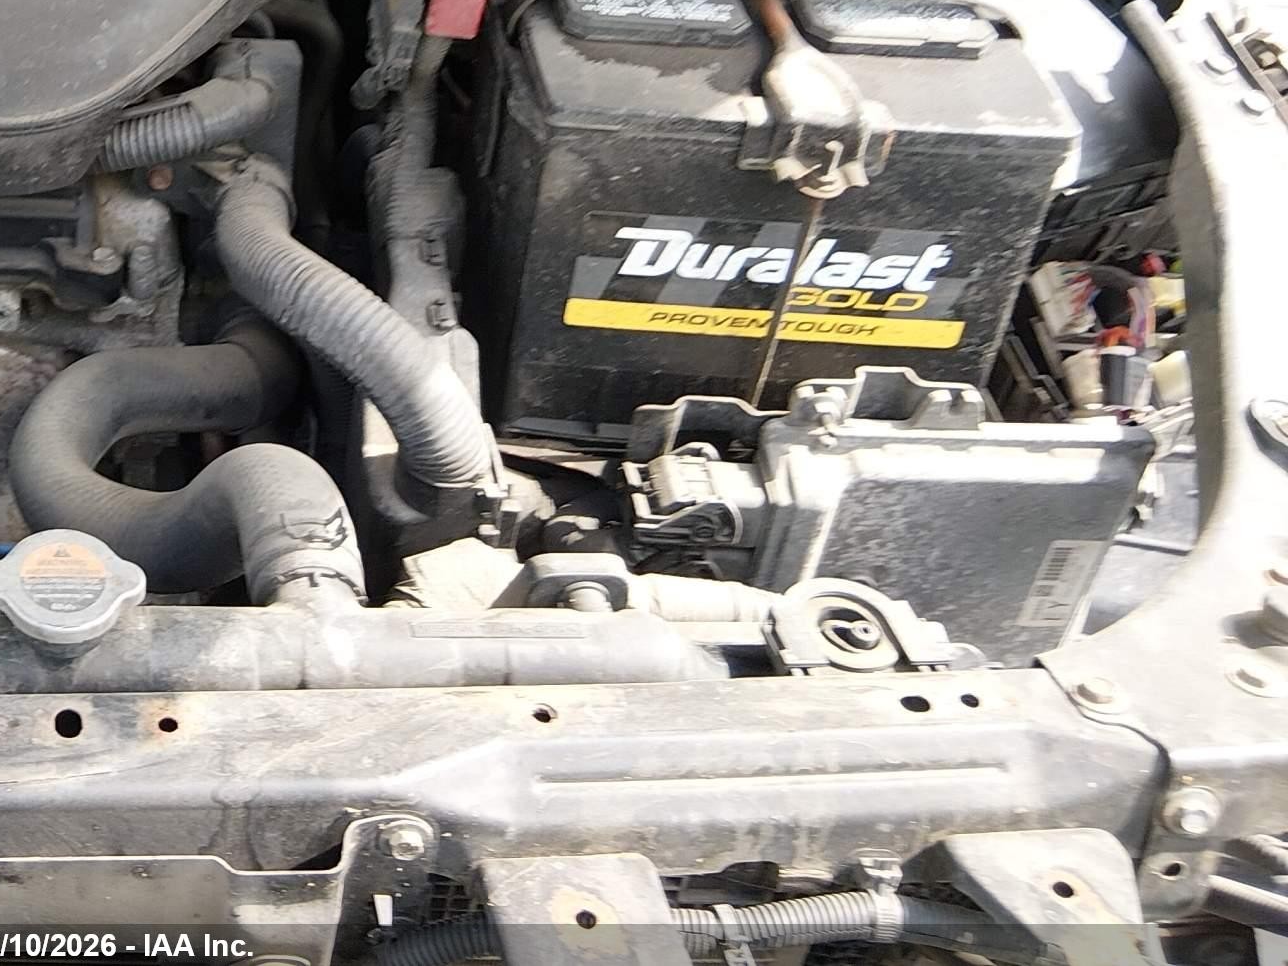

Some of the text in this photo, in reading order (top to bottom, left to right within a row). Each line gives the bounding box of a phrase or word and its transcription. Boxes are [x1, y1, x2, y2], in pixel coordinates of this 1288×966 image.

[614, 227, 954, 292] Duralast
[786, 286, 929, 312] GOLD
[648, 311, 882, 335] PROVEN TOUGH
